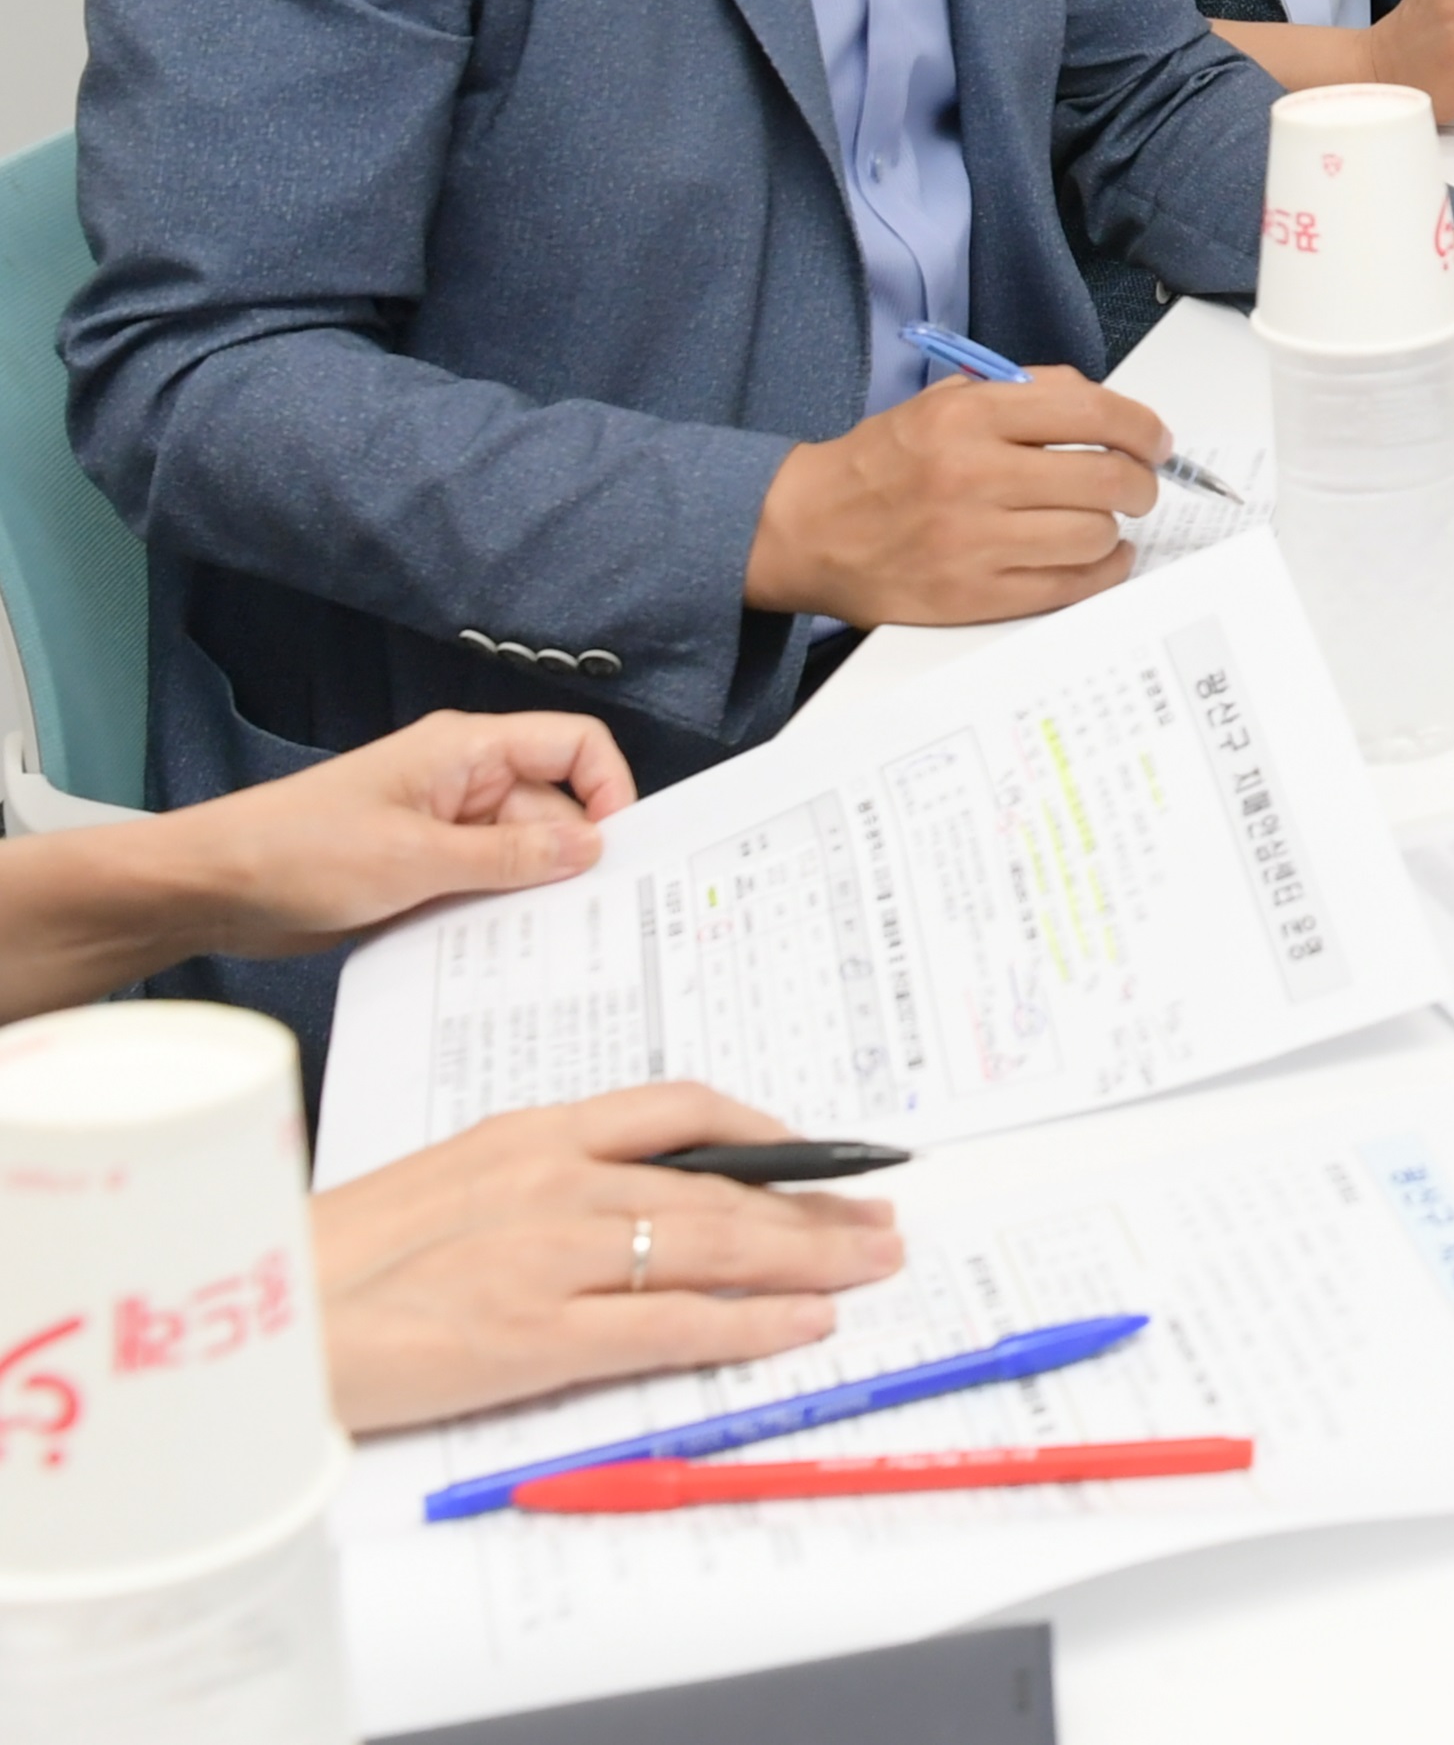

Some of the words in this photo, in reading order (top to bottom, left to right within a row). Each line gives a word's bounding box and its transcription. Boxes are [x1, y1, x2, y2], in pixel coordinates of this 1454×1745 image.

[1195, 669, 1251, 753] 광산구
[1233, 768, 1305, 907] 치매안심센터
[1280, 913, 1324, 960] 운영
